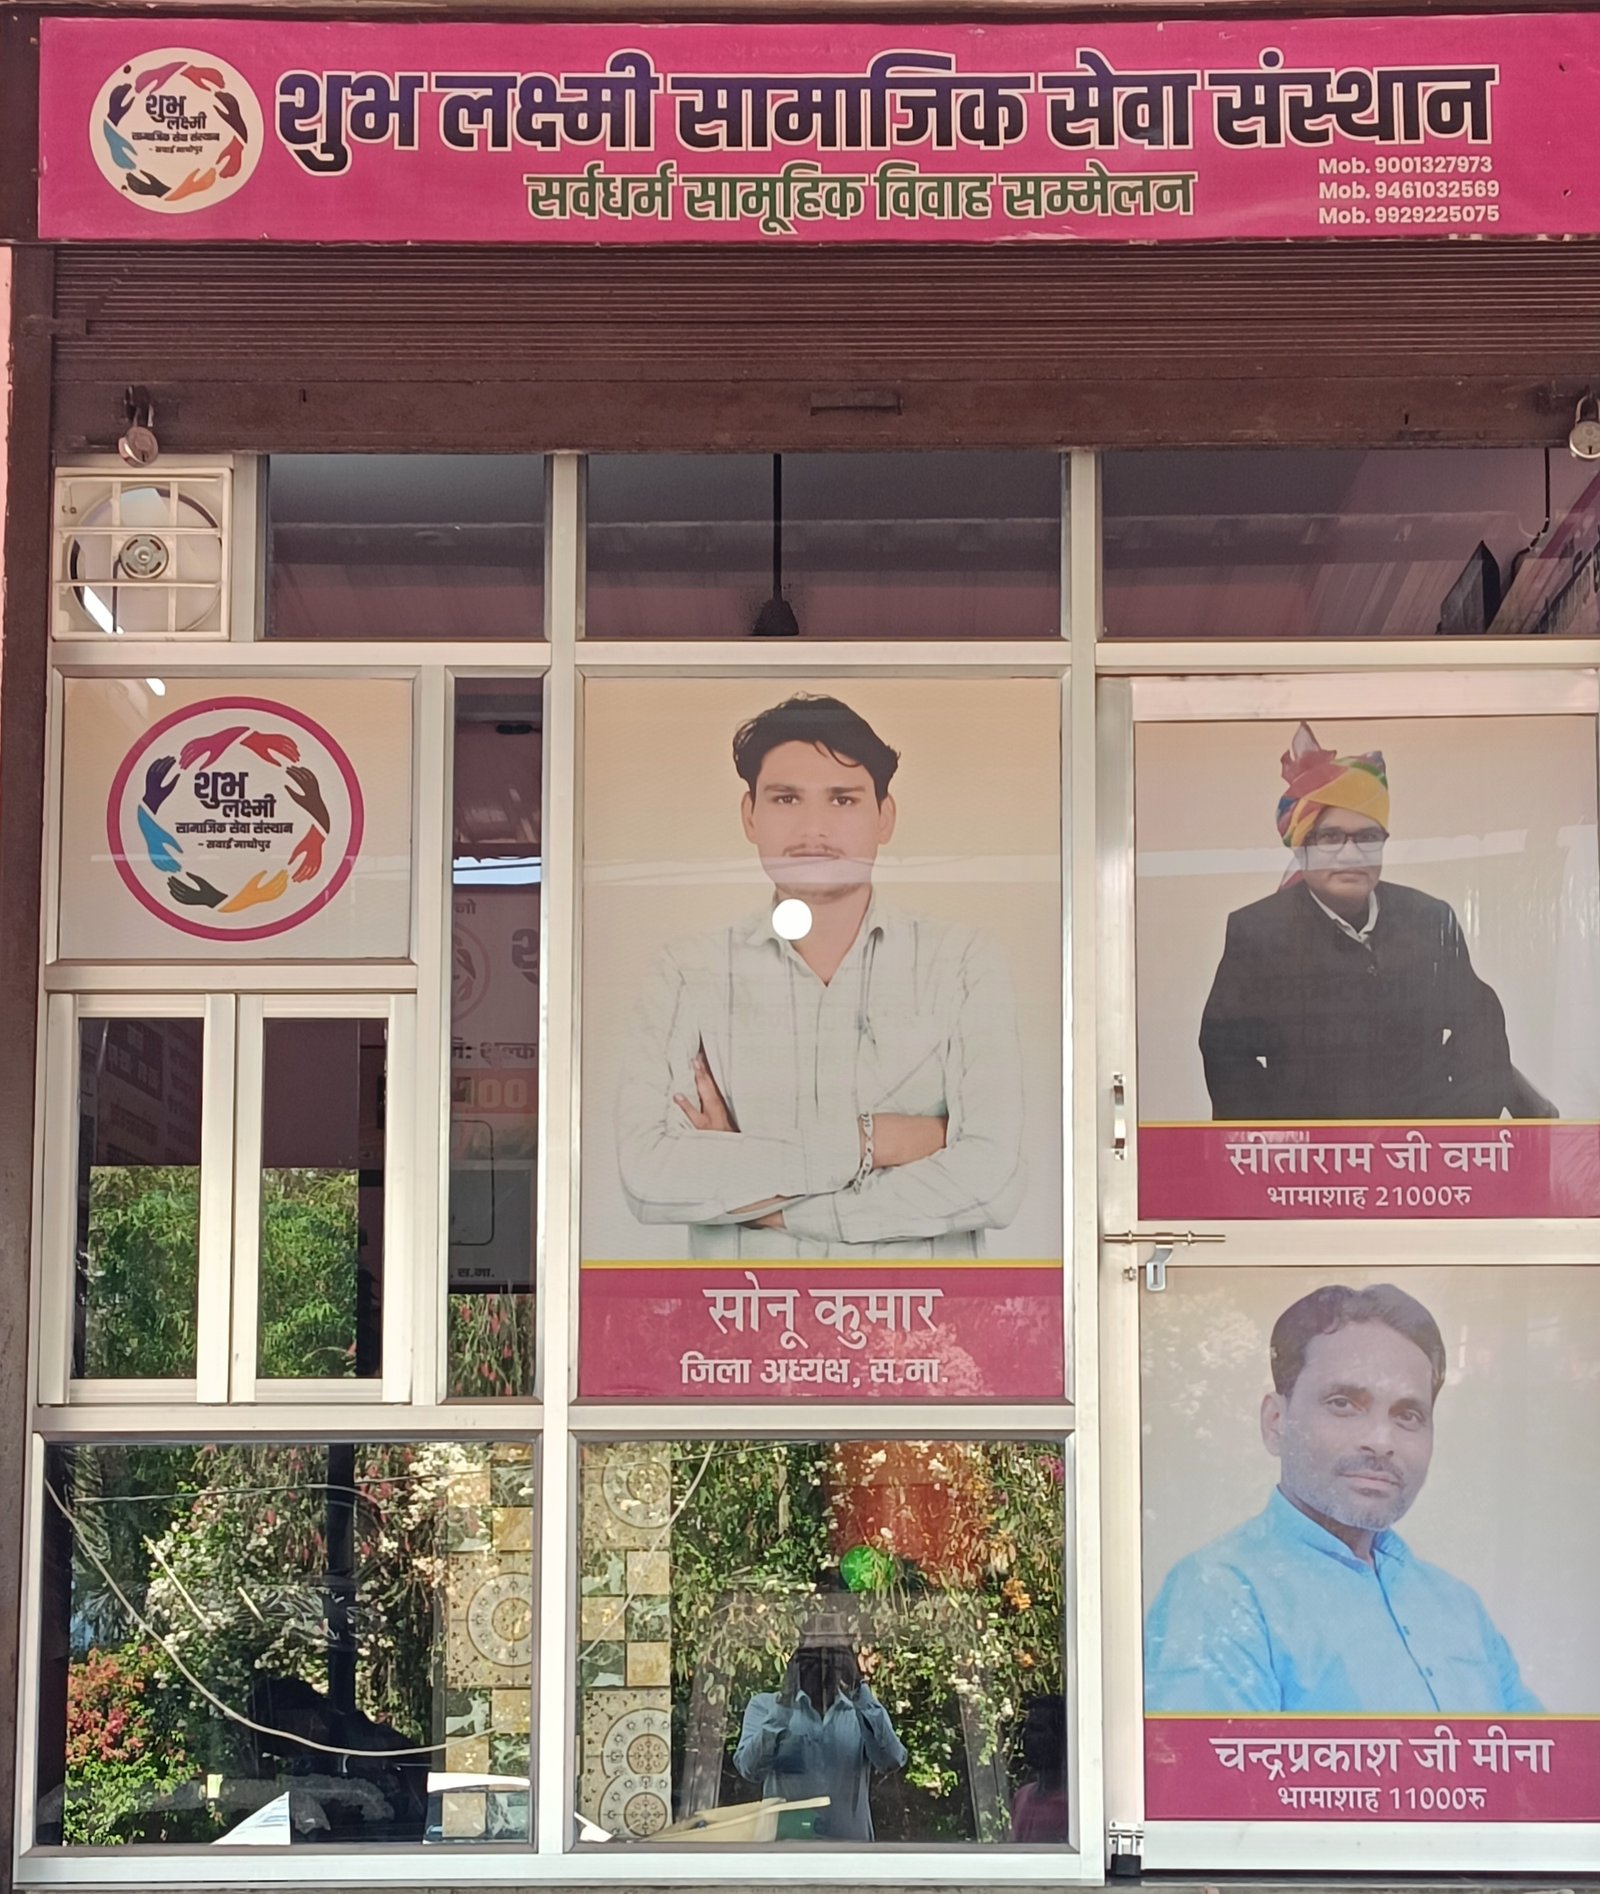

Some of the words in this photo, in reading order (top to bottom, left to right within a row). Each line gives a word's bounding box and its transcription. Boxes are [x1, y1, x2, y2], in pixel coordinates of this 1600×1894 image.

[145, 94, 187, 123] शुभ
[165, 111, 207, 130] लक्ष्मी
[275, 70, 427, 176] शुभ
[431, 48, 664, 152] लक्ष्मी
[667, 49, 1035, 151] सामाजिक
[1037, 47, 1201, 150] सेवा
[1204, 47, 1499, 149] संस्थान
[1319, 157, 1371, 175] Mob.
[1375, 156, 1493, 174] 9001327973
[523, 160, 677, 220] सर्वधर्म
[680, 160, 869, 235] सामूहिक
[872, 160, 997, 220] विवाह
[999, 160, 1198, 217] सम्मेलन
[1319, 181, 1371, 199] Mob.
[1375, 180, 1500, 199] 9461032569
[1319, 206, 1371, 224] Mob.
[1375, 205, 1500, 223] 9929225075
[194, 771, 249, 810] शुभ
[220, 793, 277, 818] लक्ष्मी
[175, 819, 226, 834] सामाजिक
[229, 819, 251, 834] सेवा
[252, 820, 294, 834] संस्थान
[1225, 1131, 1375, 1175] सीताराम
[1381, 1130, 1432, 1173] जी
[1438, 1129, 1514, 1173] वर्मा
[1267, 1186, 1369, 1209] भामाशाह
[1375, 1186, 1473, 1207] 21000रु
[702, 1271, 809, 1350] सोनू
[807, 1288, 945, 1350] कुमार
[680, 1350, 752, 1384] जिला
[760, 1358, 862, 1389] अध्यक्ष,
[868, 1358, 949, 1384] स.मा.
[1209, 1738, 1403, 1781] चन्द्रप्रकाश
[1408, 1725, 1462, 1773] जी
[1467, 1725, 1556, 1774] मीना
[1278, 1787, 1381, 1813] भामाशाह
[1389, 1787, 1487, 1811] 11000रु
